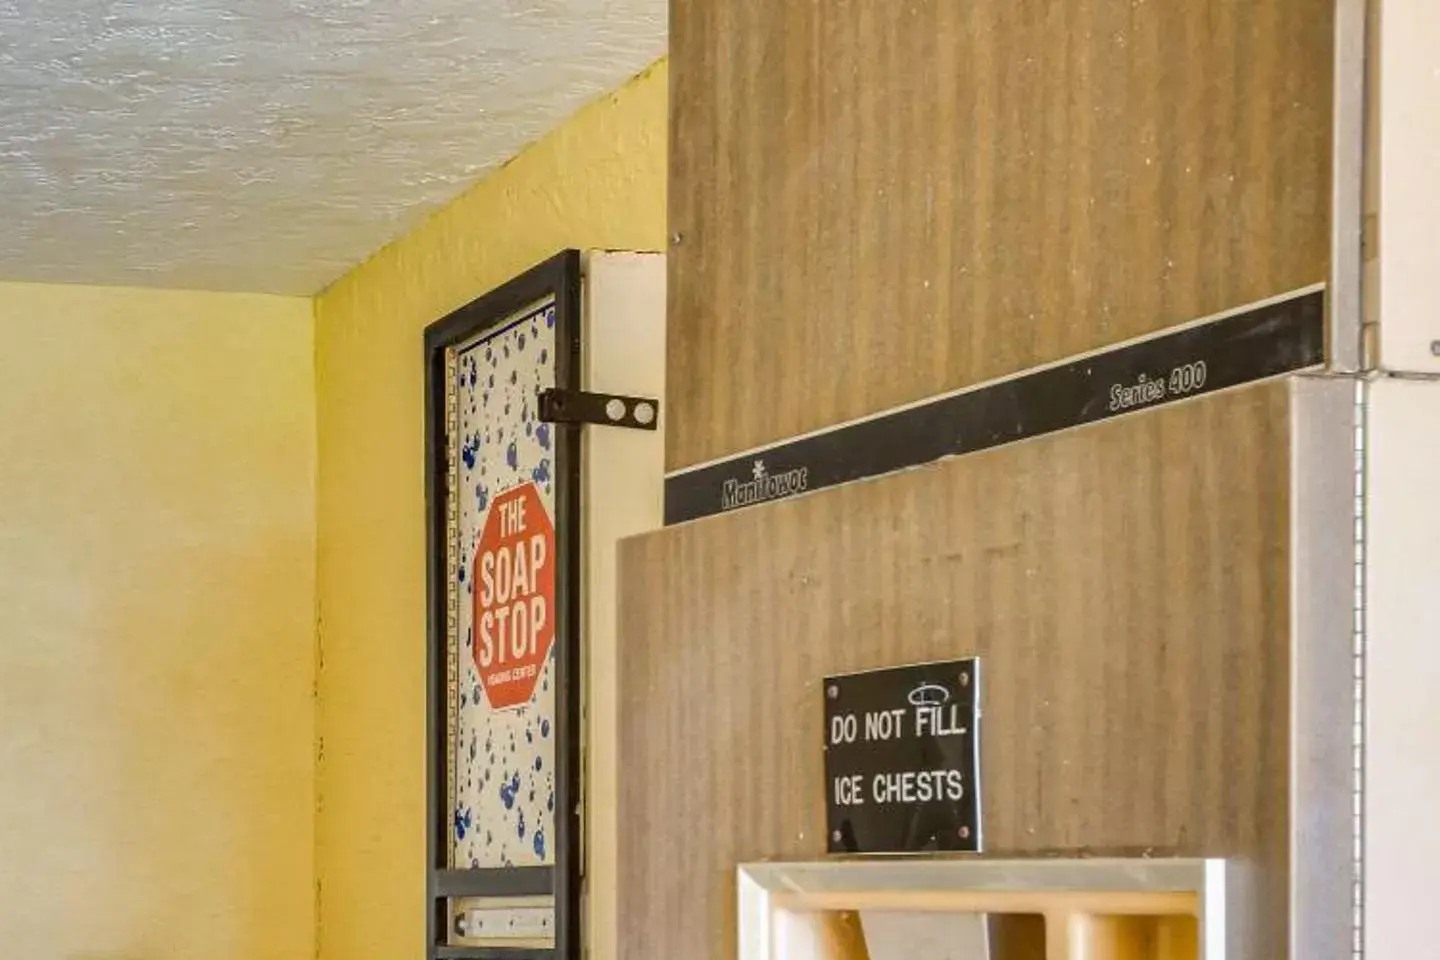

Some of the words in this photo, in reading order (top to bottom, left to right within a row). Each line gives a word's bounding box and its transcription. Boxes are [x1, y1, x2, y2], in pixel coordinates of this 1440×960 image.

[1109, 373, 1166, 411] Series
[1168, 360, 1207, 394] 400
[721, 463, 808, 510] Manitowoc
[498, 495, 527, 538] THE
[480, 534, 546, 609] SOAP
[479, 596, 546, 668] STOP
[831, 715, 857, 744] DO
[865, 708, 906, 741] NOT
[914, 704, 966, 737] FILL
[834, 775, 864, 805] ICE
[872, 770, 964, 803] CHESTS
